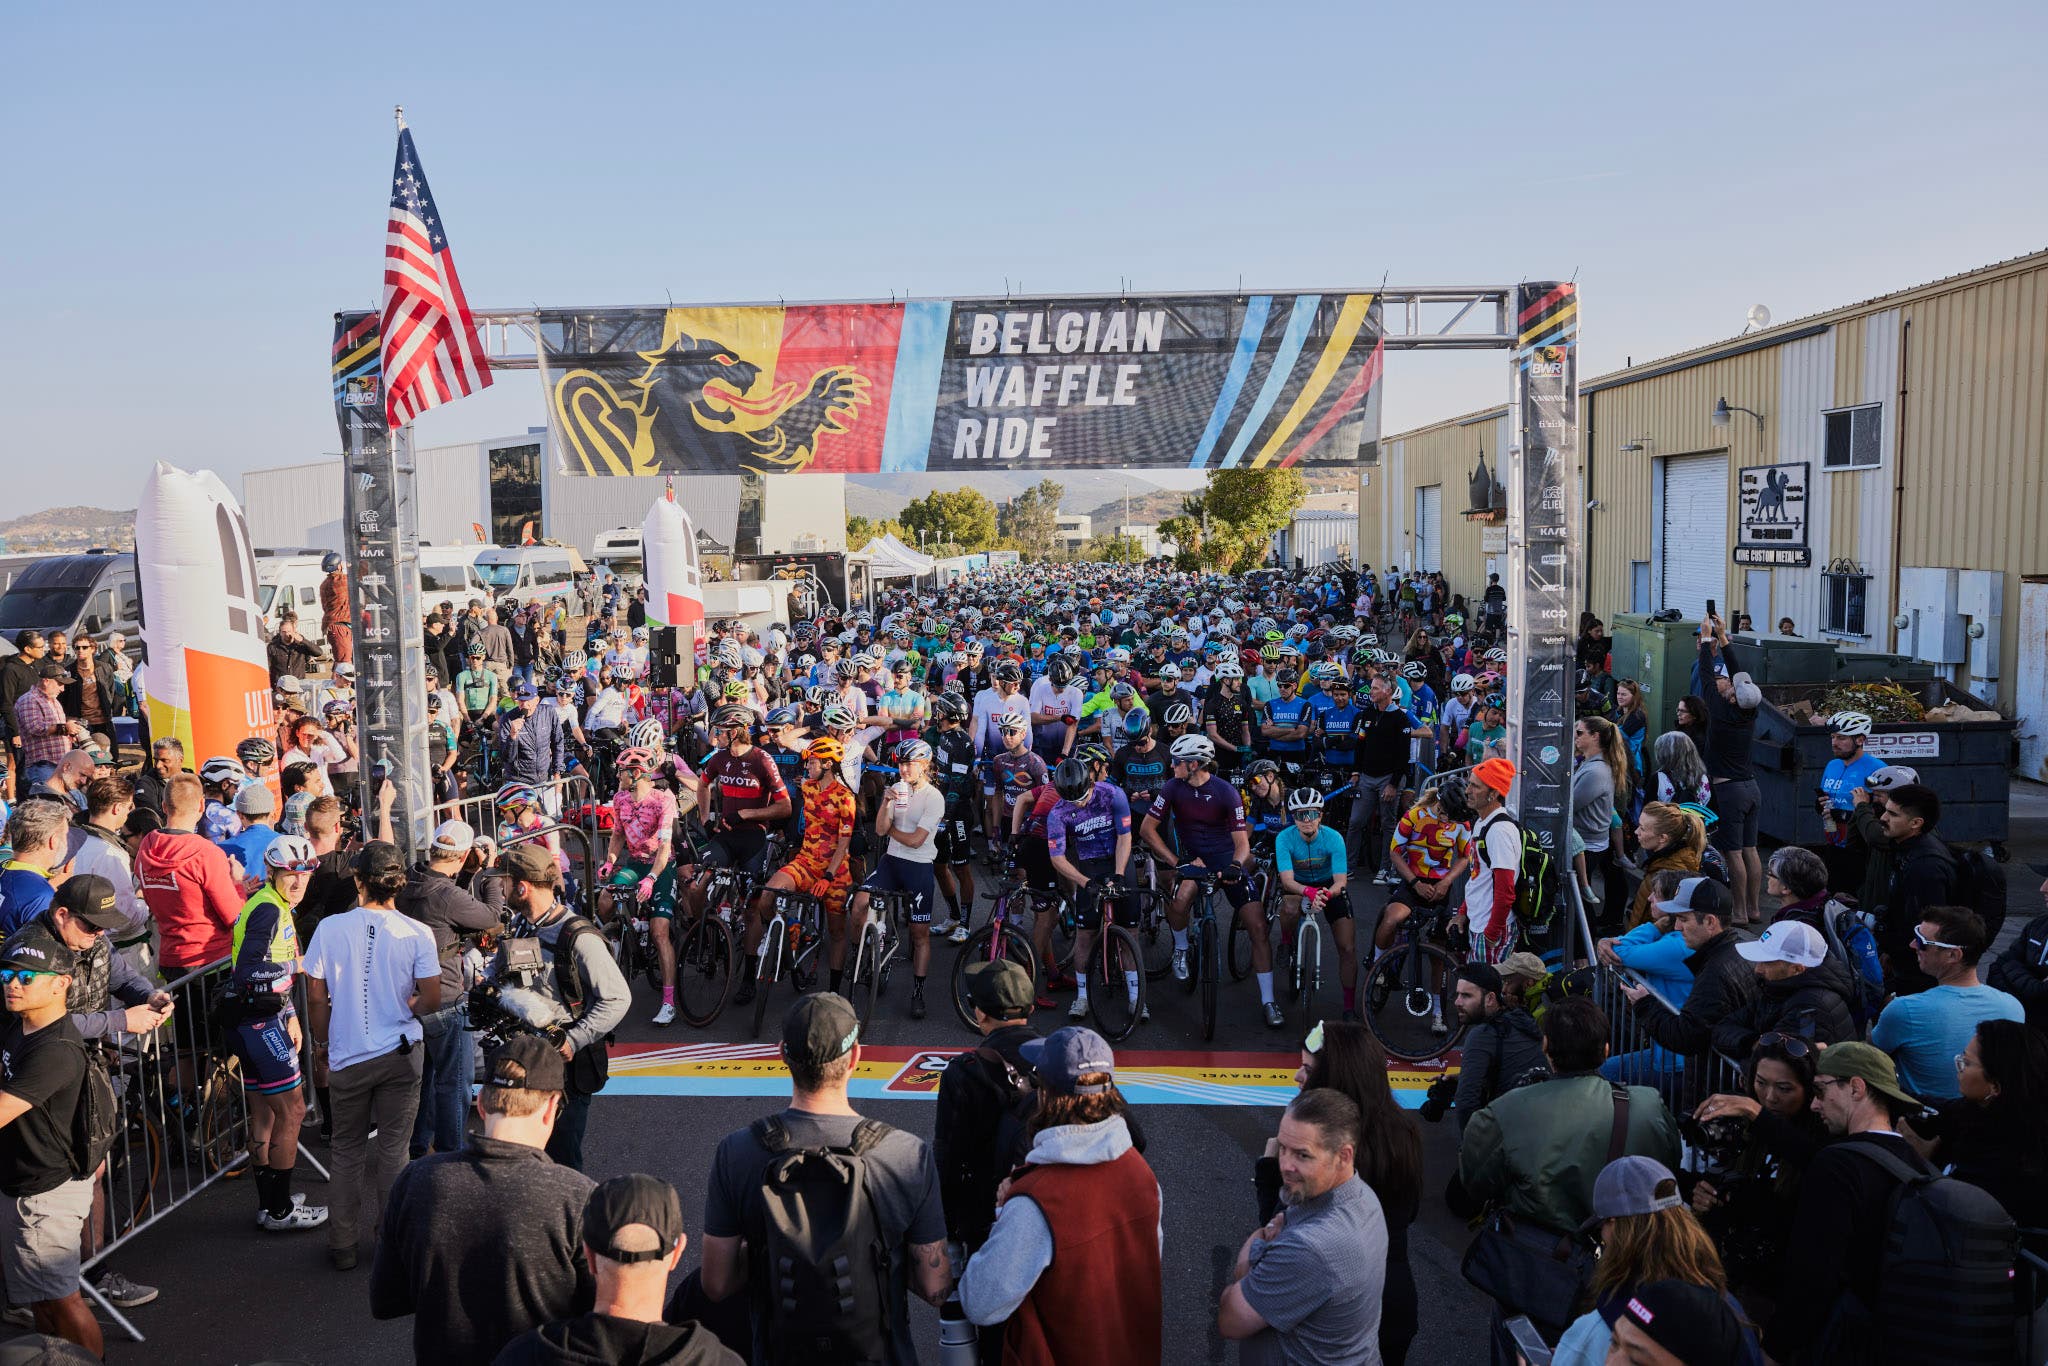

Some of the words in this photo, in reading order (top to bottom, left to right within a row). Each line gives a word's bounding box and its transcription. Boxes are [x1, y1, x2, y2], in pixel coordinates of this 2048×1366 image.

[968, 311, 1166, 355] BELGIAN
[1532, 363, 1562, 374] BWR
[966, 364, 1141, 407] WAFFLE
[346, 392, 375, 403] BWR
[952, 417, 1056, 459] RIDE
[360, 523, 380, 533] ELIEL
[1736, 549, 1750, 561] KING
[1750, 550, 1775, 562] CUSTOM
[1775, 550, 1795, 563] METAL
[1542, 609, 1568, 619] KOO
[366, 627, 390, 637] KOO
[1865, 735, 1935, 746] EDCO
[1130, 765, 1159, 773] ABUS
[720, 775, 760, 788] TOYOTA
